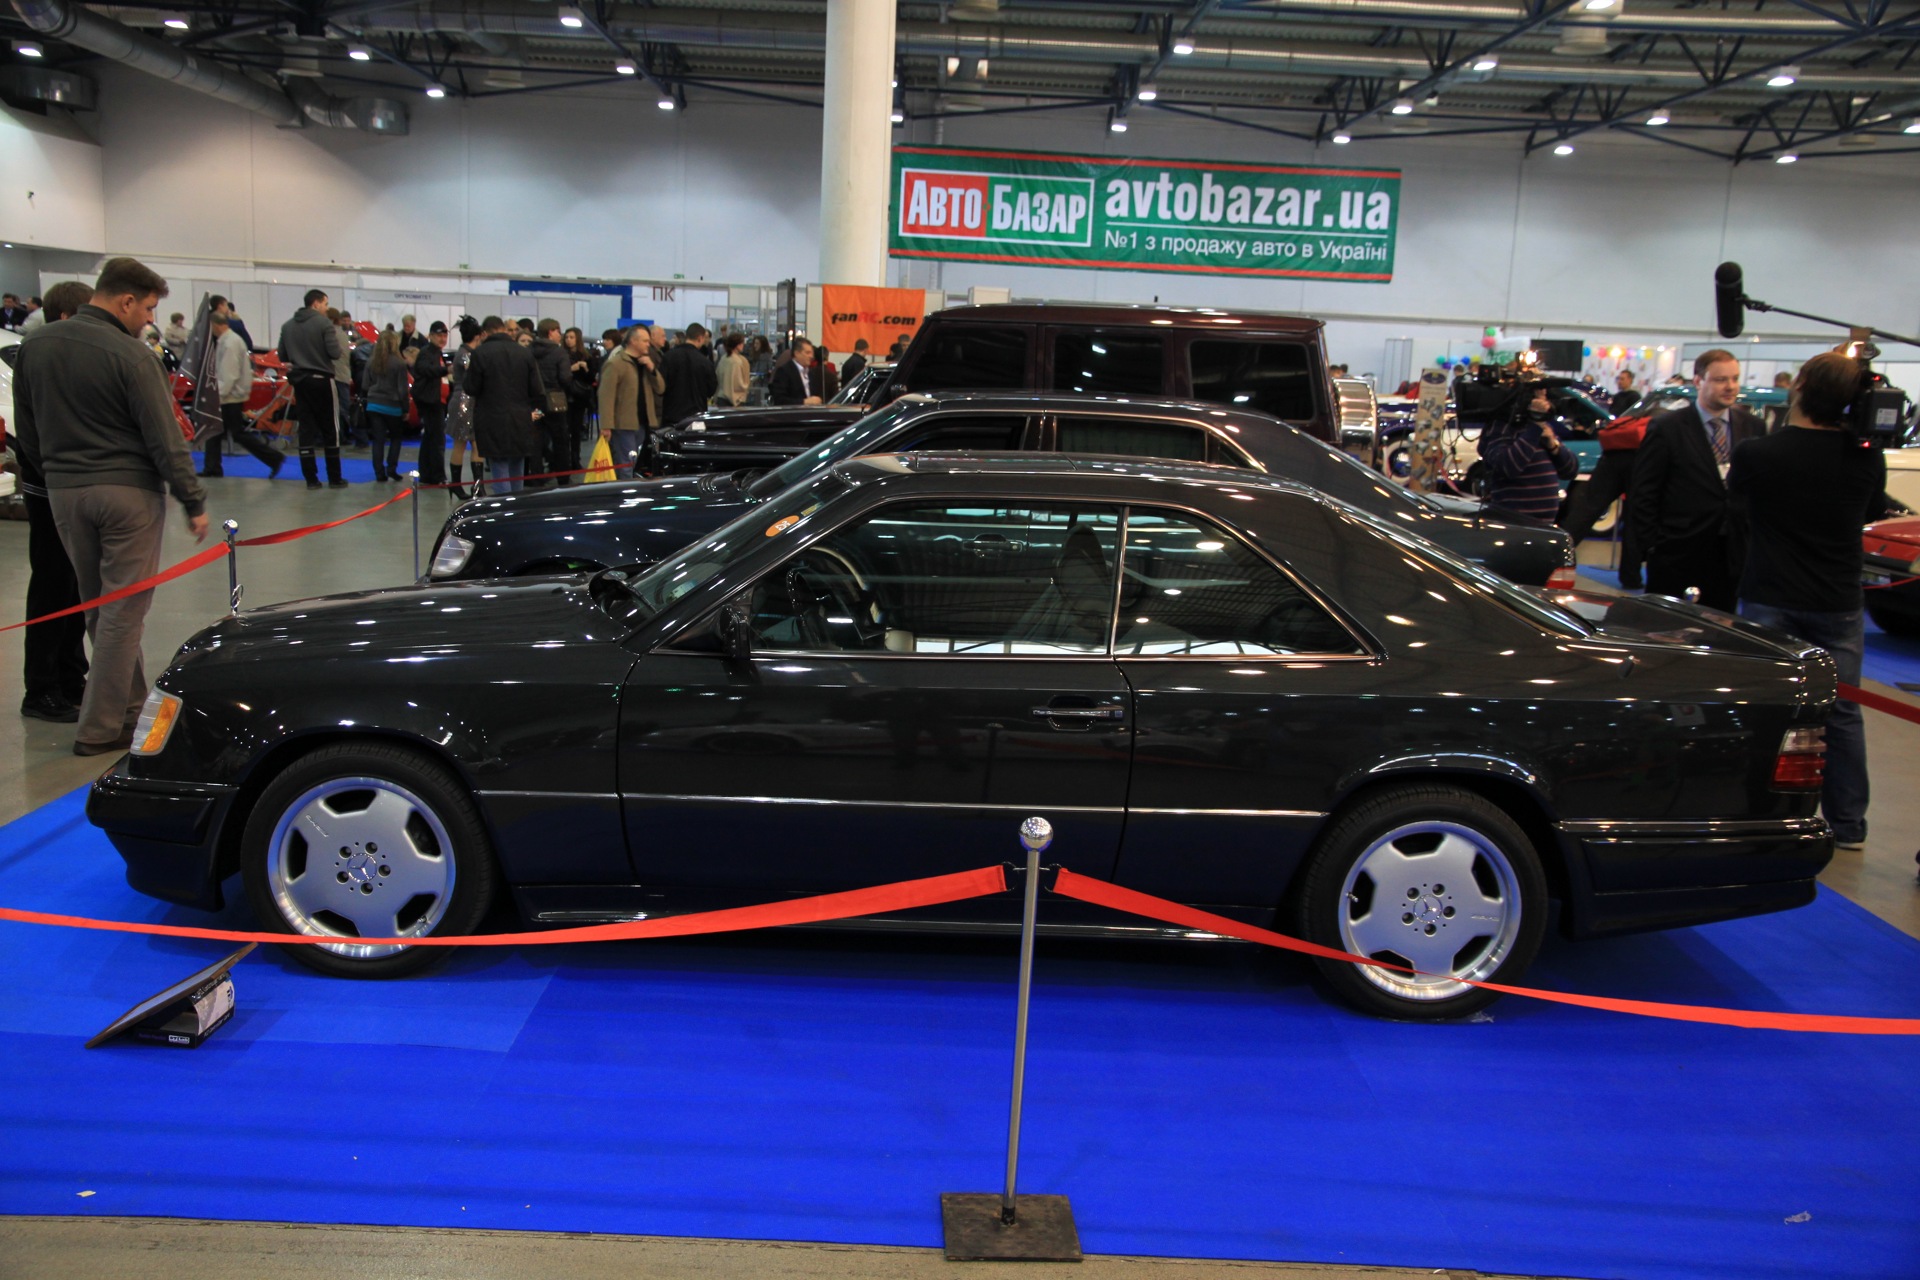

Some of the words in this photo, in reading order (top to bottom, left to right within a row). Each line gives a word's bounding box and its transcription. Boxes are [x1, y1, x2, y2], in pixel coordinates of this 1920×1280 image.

[992, 184, 1087, 234] БАЗАР
[1105, 172, 1391, 230] avtobazar.ua
[1105, 230, 1137, 249] №1
[1145, 235, 1156, 250] з
[1162, 236, 1247, 259] продажу
[1252, 241, 1296, 258] авто
[1302, 243, 1313, 258] в
[1319, 240, 1388, 263] Україні
[831, 311, 916, 325] fanRC.com
